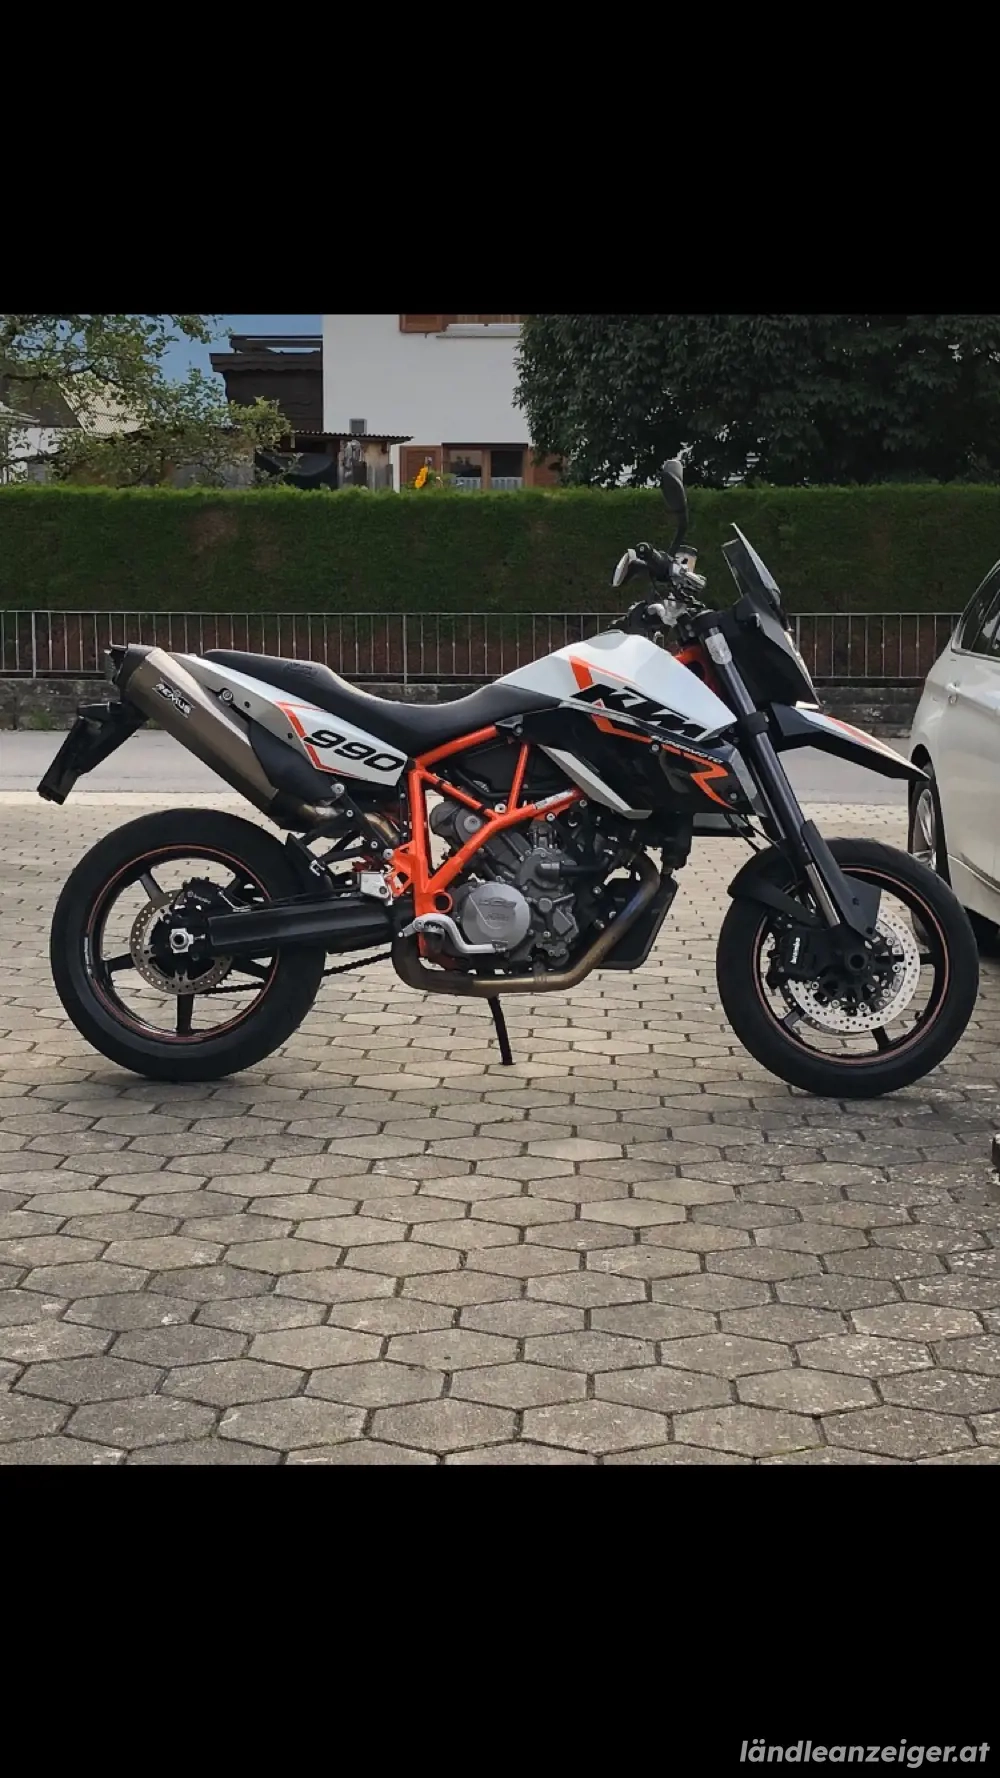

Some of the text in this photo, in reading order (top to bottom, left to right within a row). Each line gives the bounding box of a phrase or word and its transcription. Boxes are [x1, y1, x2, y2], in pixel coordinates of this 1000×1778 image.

[155, 683, 191, 714] REMUS
[569, 683, 708, 740] KTM
[303, 729, 406, 772] 990
